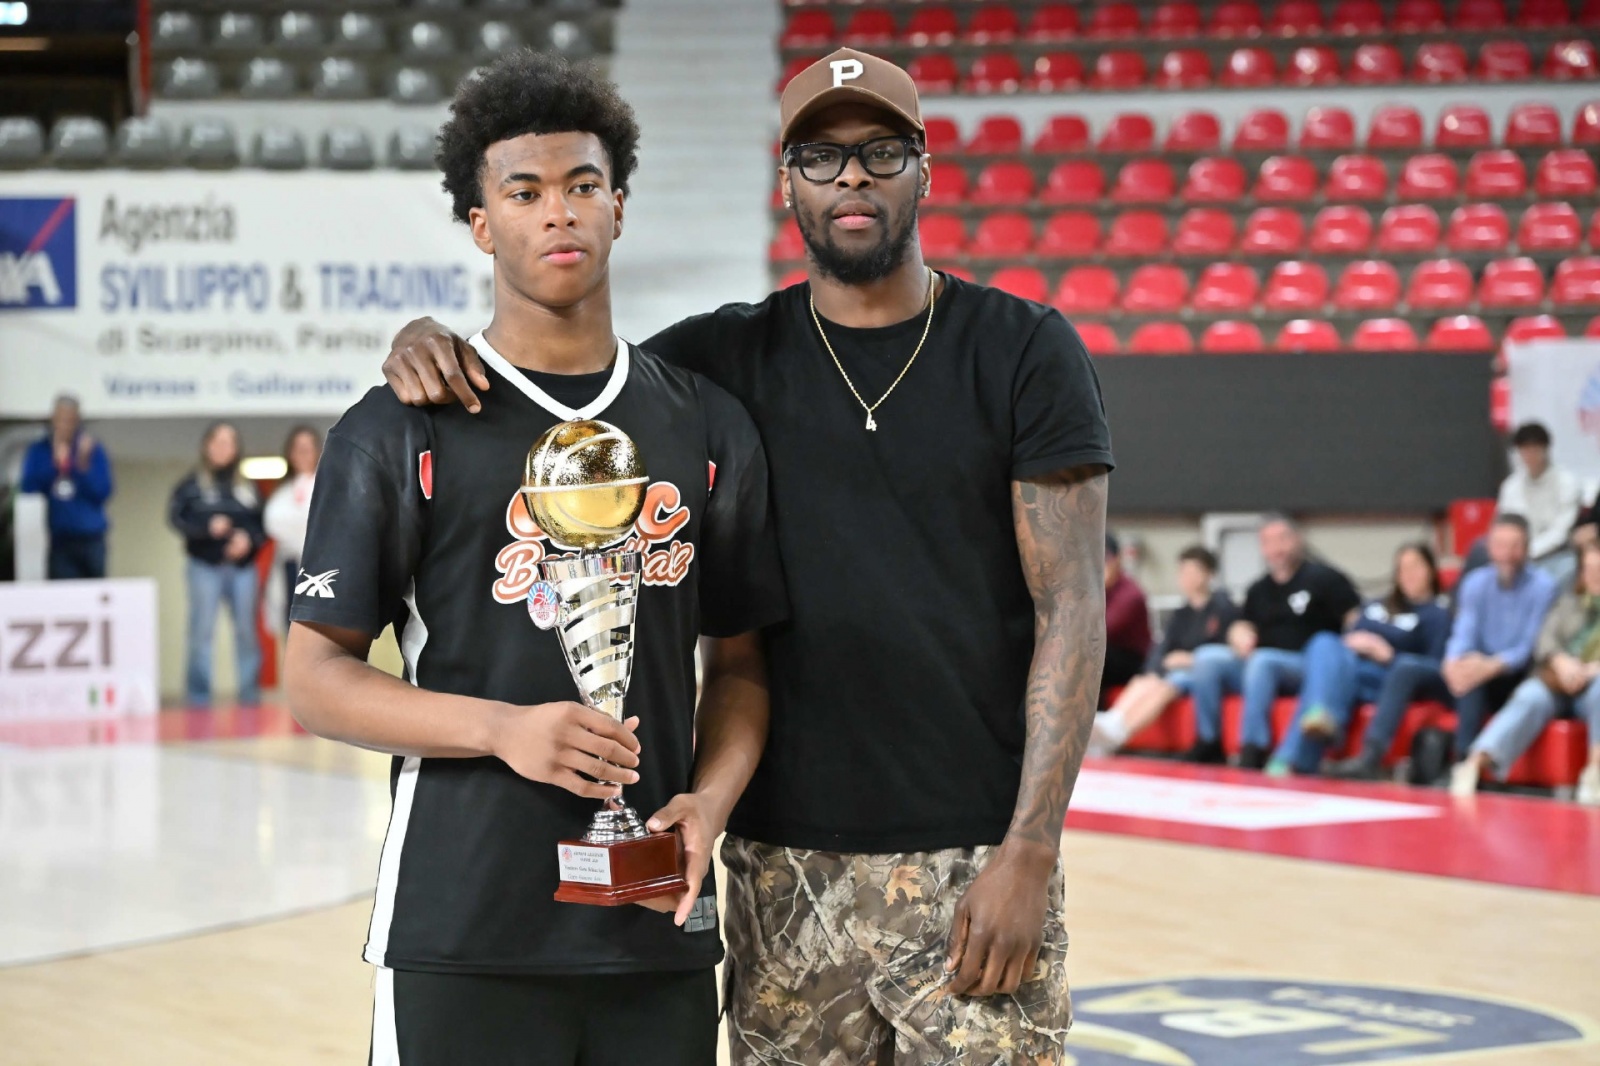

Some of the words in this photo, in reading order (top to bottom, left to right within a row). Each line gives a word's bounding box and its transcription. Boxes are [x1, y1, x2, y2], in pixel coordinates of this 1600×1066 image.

[829, 58, 864, 88] P
[100, 194, 236, 252] Agenzia
[99, 262, 265, 312] SVILUPPO
[280, 265, 304, 310] &
[318, 262, 471, 312] TRADING
[0, 592, 113, 671] zzi
